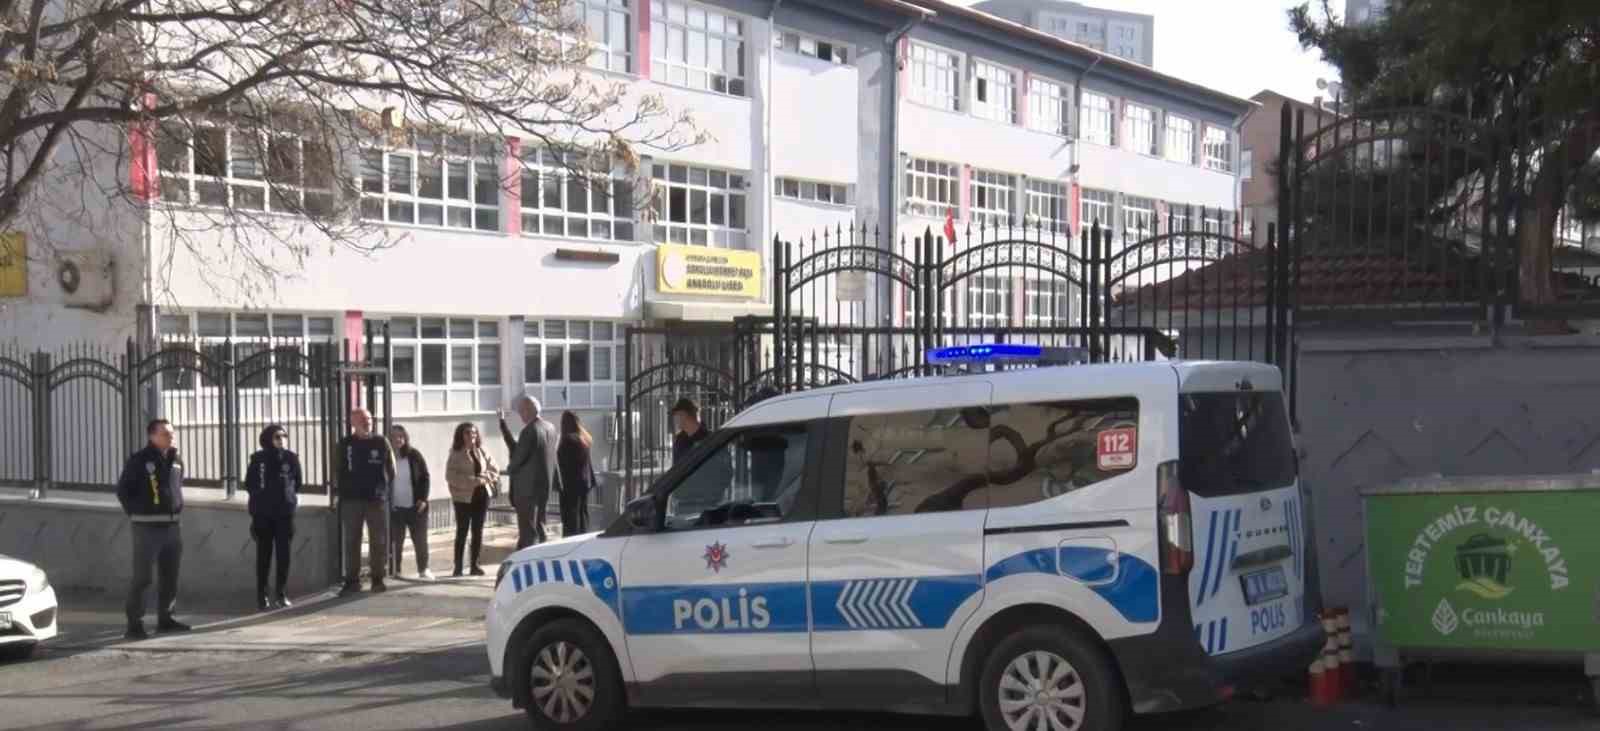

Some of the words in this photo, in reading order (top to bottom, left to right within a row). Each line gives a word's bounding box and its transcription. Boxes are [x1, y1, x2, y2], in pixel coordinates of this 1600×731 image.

[1103, 433, 1129, 452] 112
[1405, 504, 1478, 590] TERTEMİZ
[1484, 506, 1569, 590] ÇANKAYA
[673, 587, 770, 629] POLİS
[1461, 607, 1544, 628] Çankaya
